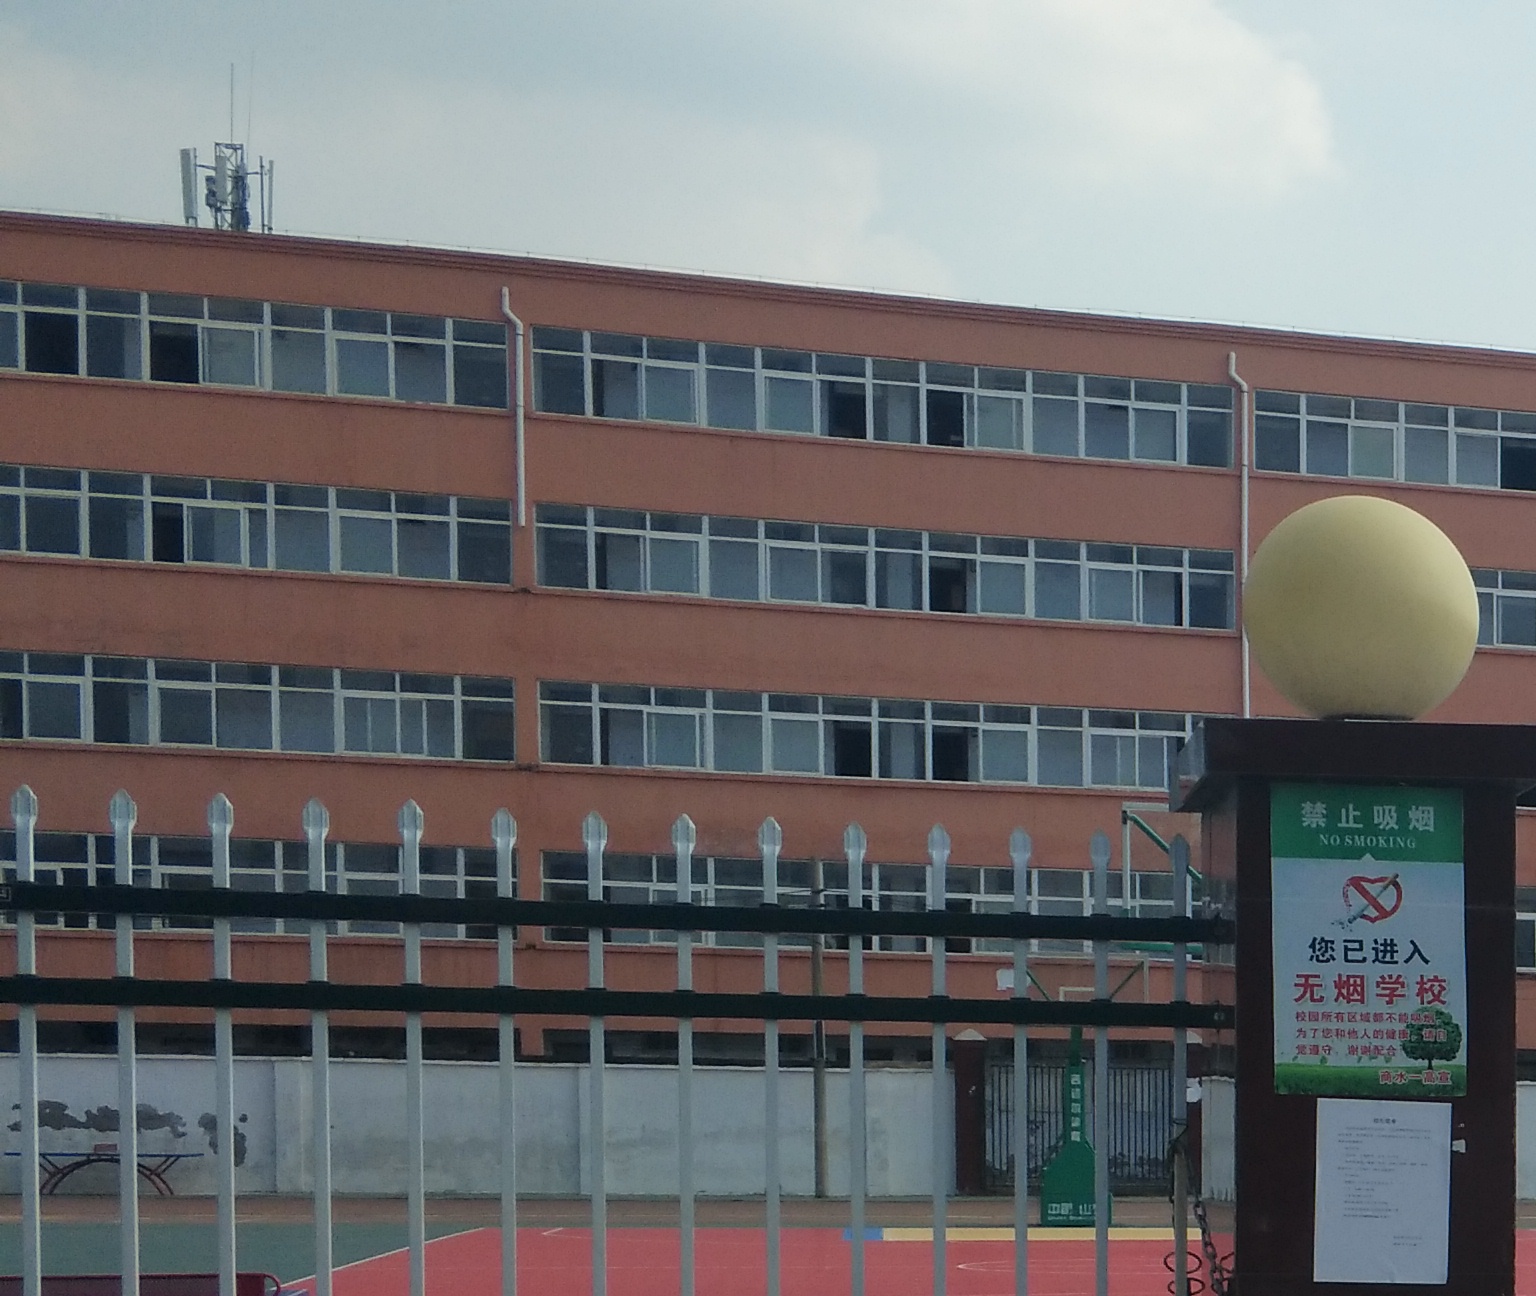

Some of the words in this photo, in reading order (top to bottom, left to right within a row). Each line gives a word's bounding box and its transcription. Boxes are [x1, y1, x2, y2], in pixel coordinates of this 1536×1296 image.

[1301, 801, 1435, 832] 禁止吸烟
[1319, 833, 1341, 846] NO
[1344, 834, 1417, 849] SMOKING
[1308, 936, 1431, 965] 您已进入
[1294, 973, 1447, 1006] 无烟学校
